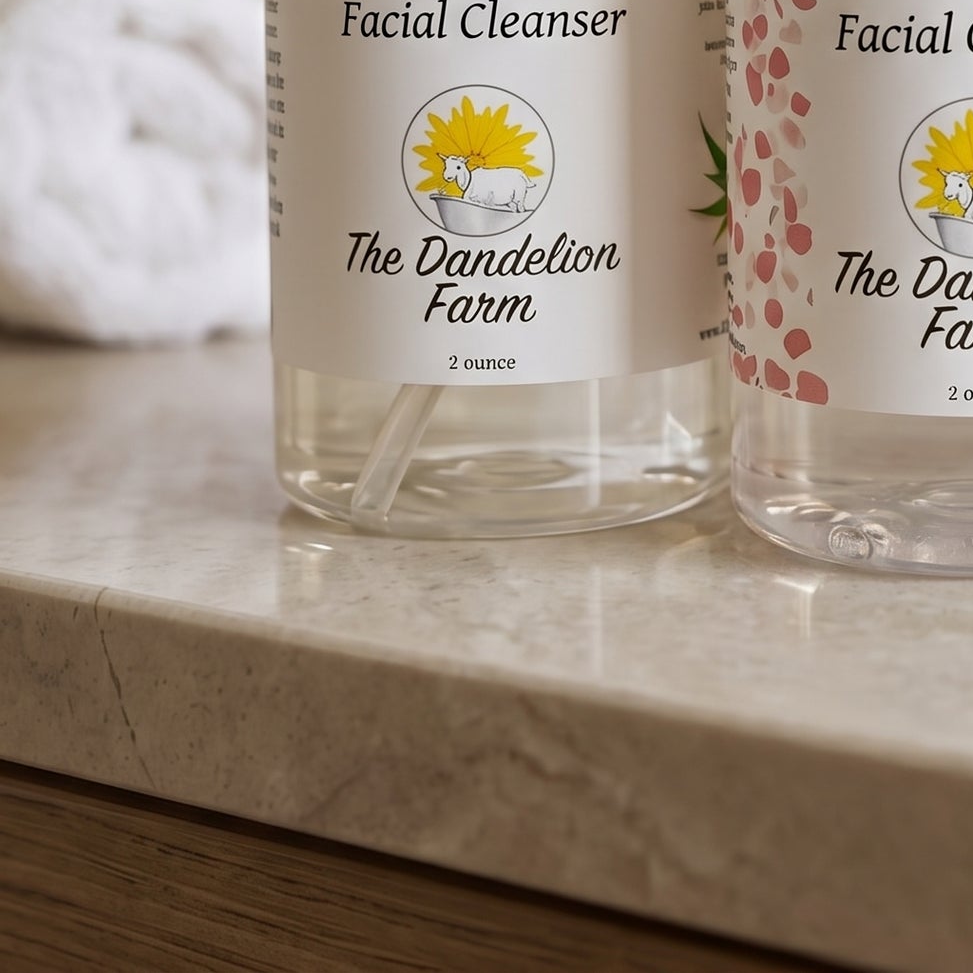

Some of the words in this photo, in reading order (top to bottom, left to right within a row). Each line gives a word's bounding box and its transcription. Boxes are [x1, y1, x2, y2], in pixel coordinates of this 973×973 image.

[834, 10, 954, 55] Facial
[346, 230, 405, 276] The
[415, 232, 622, 278] Dandelion
[834, 249, 900, 298] The
[423, 282, 537, 324] Farm
[448, 354, 458, 370] 2
[464, 357, 516, 371] ounce
[948, 385, 958, 401] 2
